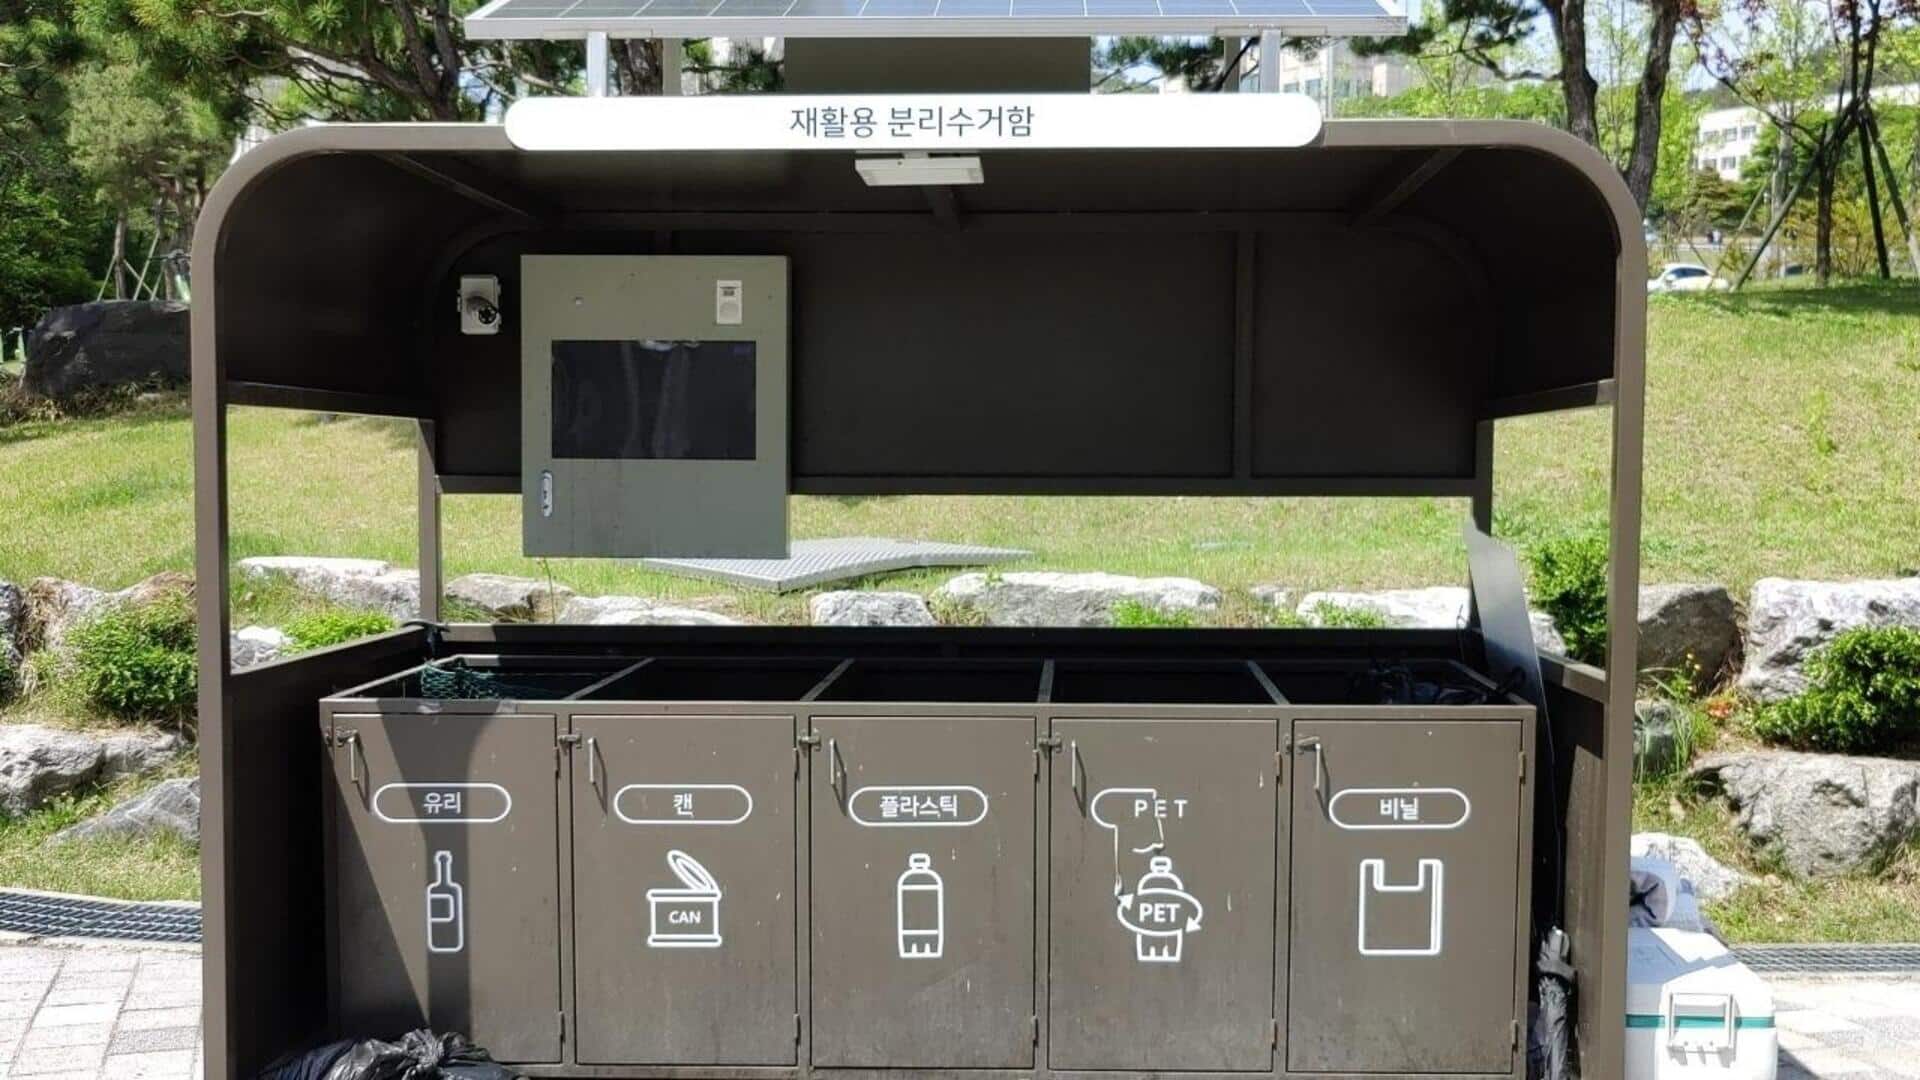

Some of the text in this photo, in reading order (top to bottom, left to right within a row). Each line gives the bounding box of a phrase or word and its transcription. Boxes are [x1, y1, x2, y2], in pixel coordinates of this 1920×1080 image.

[790, 105, 1035, 138] 재활용 분리수거함
[423, 791, 461, 814] 유리
[673, 793, 694, 817] 캔
[879, 794, 958, 819] 플라스틱
[1134, 798, 1188, 818] PET
[1380, 797, 1418, 820] 비닐
[668, 910, 701, 925] CAN
[1139, 902, 1181, 923] PET
